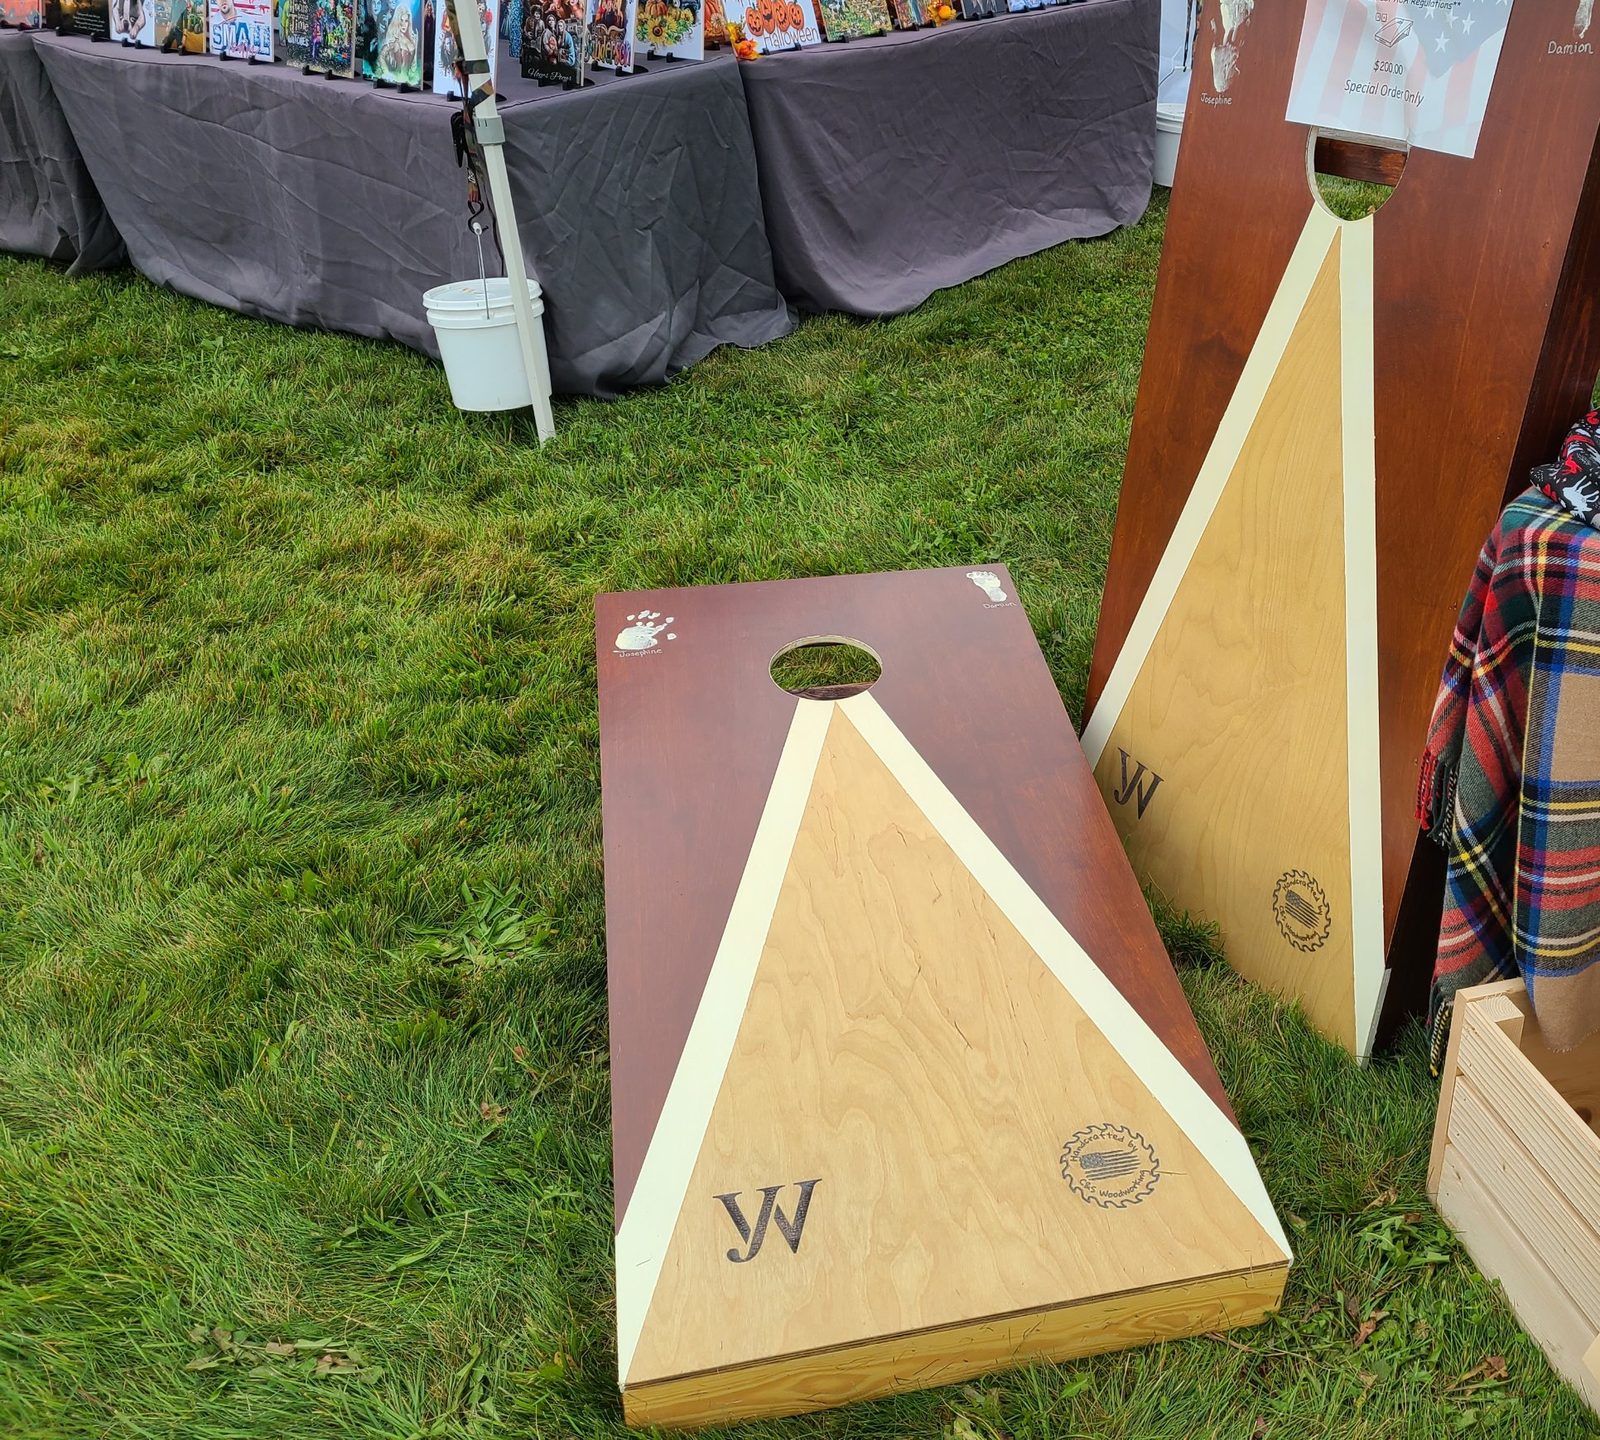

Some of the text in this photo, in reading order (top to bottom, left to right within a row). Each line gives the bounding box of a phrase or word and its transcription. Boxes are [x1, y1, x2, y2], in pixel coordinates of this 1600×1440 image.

[213, 21, 270, 56] SMALL
[763, 27, 819, 48] Halloween
[1548, 41, 1594, 54] Damion
[1373, 60, 1404, 75] $200.00
[1200, 92, 1233, 109] Josephine
[1344, 79, 1424, 107] Special Order Only
[614, 649, 663, 658] Josephine
[1069, 1130, 1125, 1162] Handcrafted
[1080, 1170, 1146, 1198] C&S Woodworking
